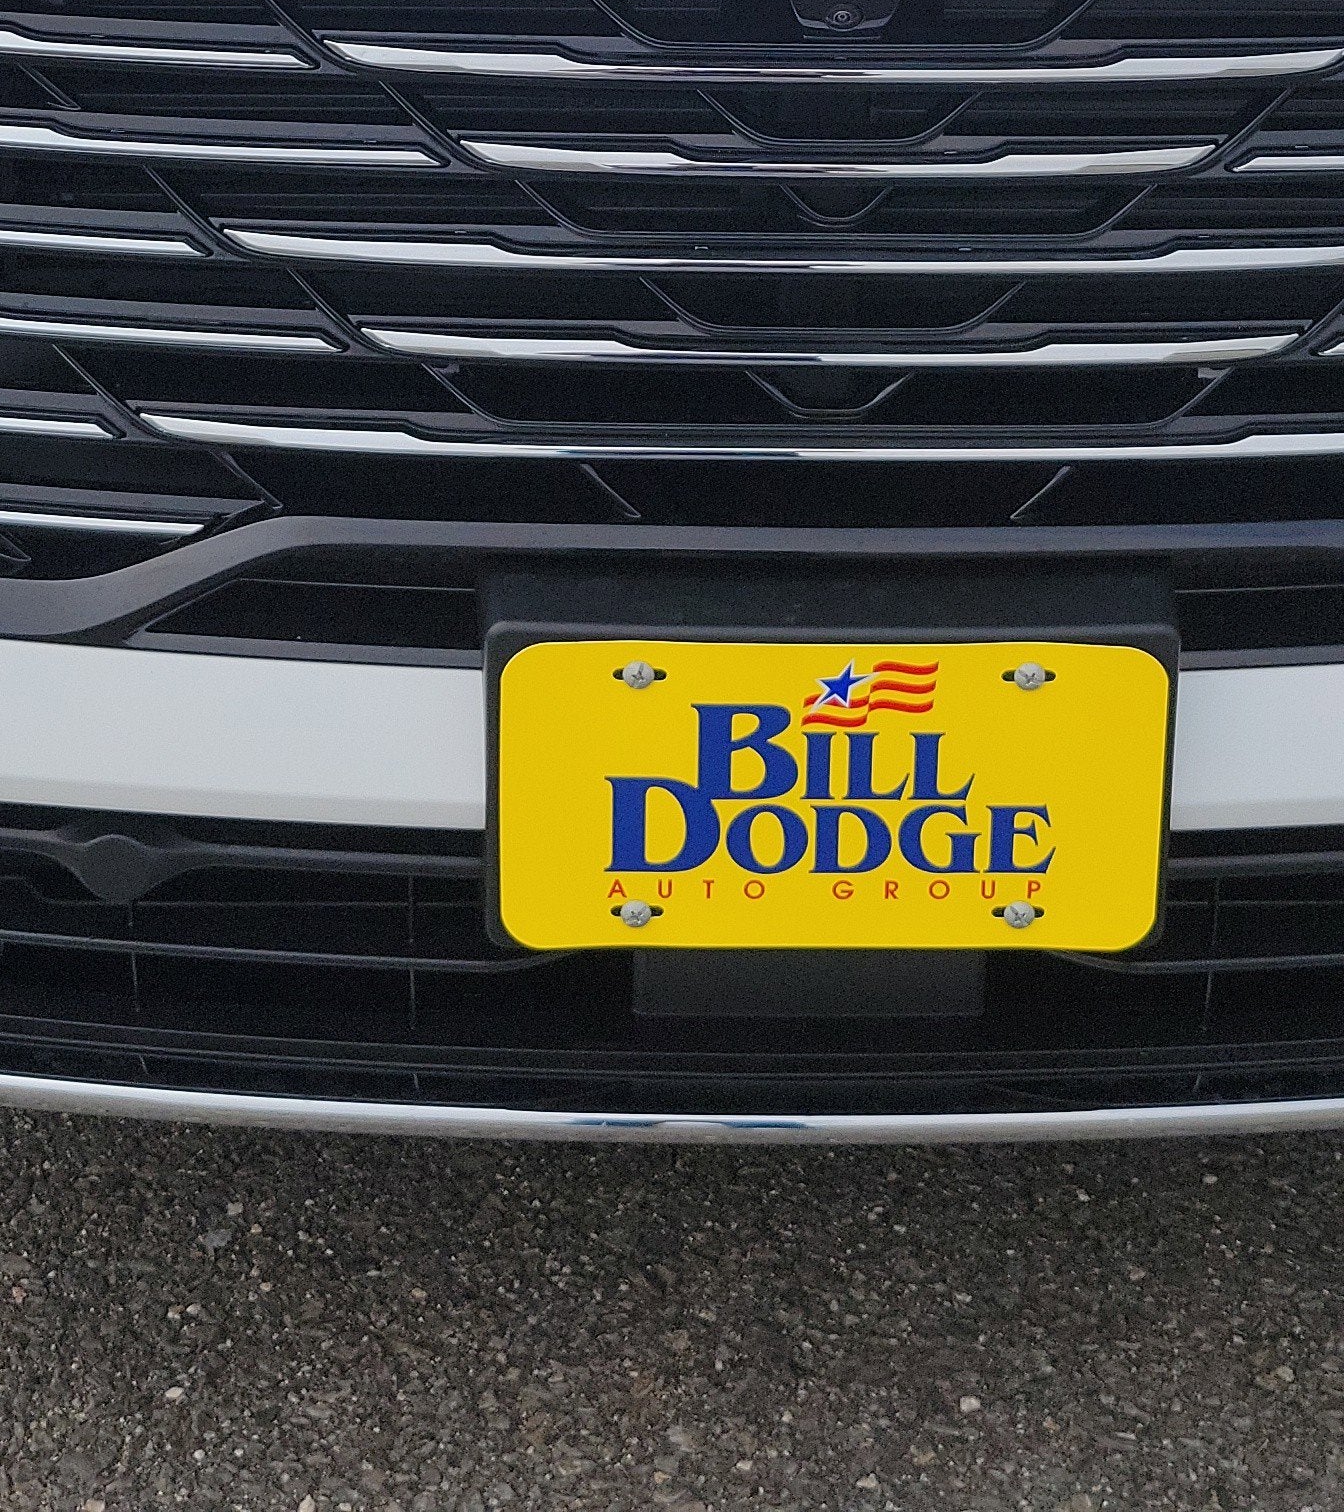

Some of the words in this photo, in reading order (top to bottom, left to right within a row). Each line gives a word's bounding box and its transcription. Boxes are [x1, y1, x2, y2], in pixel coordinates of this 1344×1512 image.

[693, 703, 976, 801] BILL
[603, 776, 1056, 874] DODGE
[607, 879, 767, 900] AUTO
[833, 879, 1043, 900] GROUP
